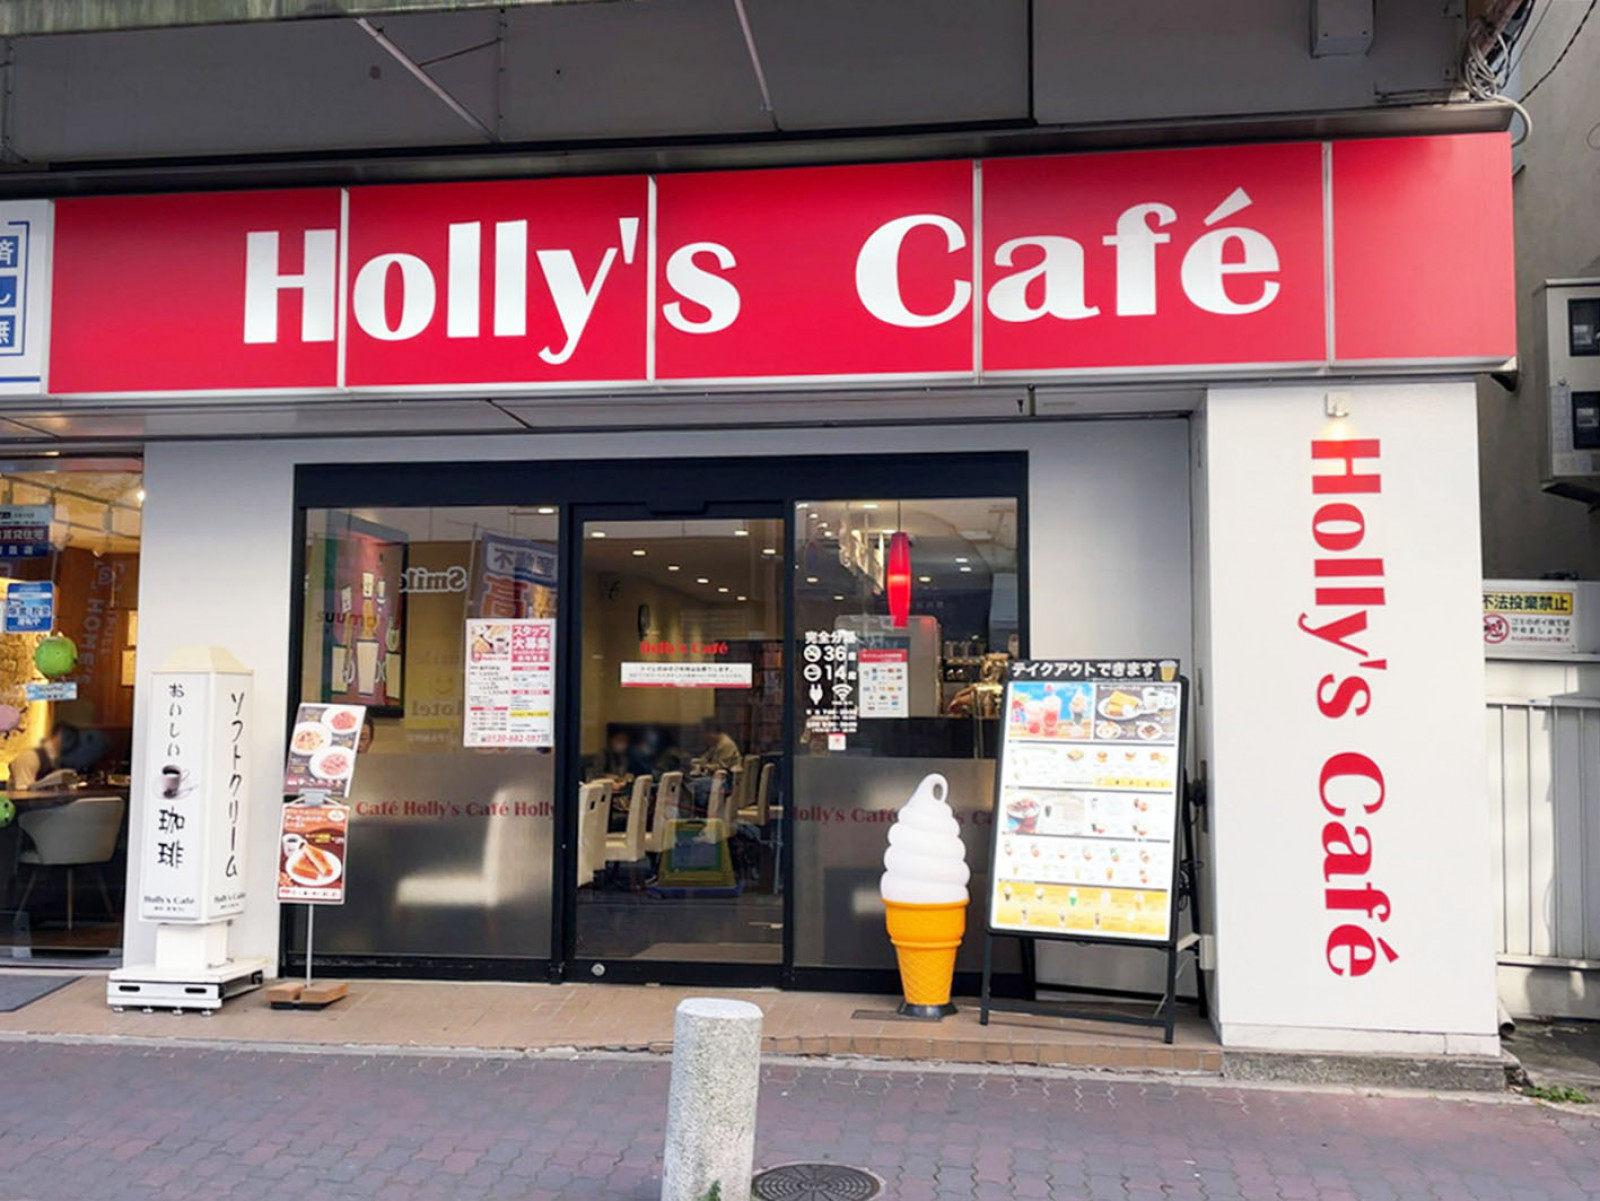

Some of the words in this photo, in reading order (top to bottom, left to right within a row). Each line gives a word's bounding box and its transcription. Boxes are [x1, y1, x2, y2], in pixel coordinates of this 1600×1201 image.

[243, 217, 741, 365] Holly's
[855, 187, 1281, 328] Café
[1298, 438, 1388, 719] Holly's
[513, 626, 550, 637] スタッフ
[1012, 662, 1156, 677] テイクアウトできます
[168, 683, 185, 757] おいしい
[225, 692, 244, 878] ソフトクリーム
[356, 802, 398, 815] Café
[403, 801, 460, 819] Holly's
[466, 802, 509, 816] Café
[157, 806, 185, 869] 珈琲
[1319, 752, 1400, 977] Café
